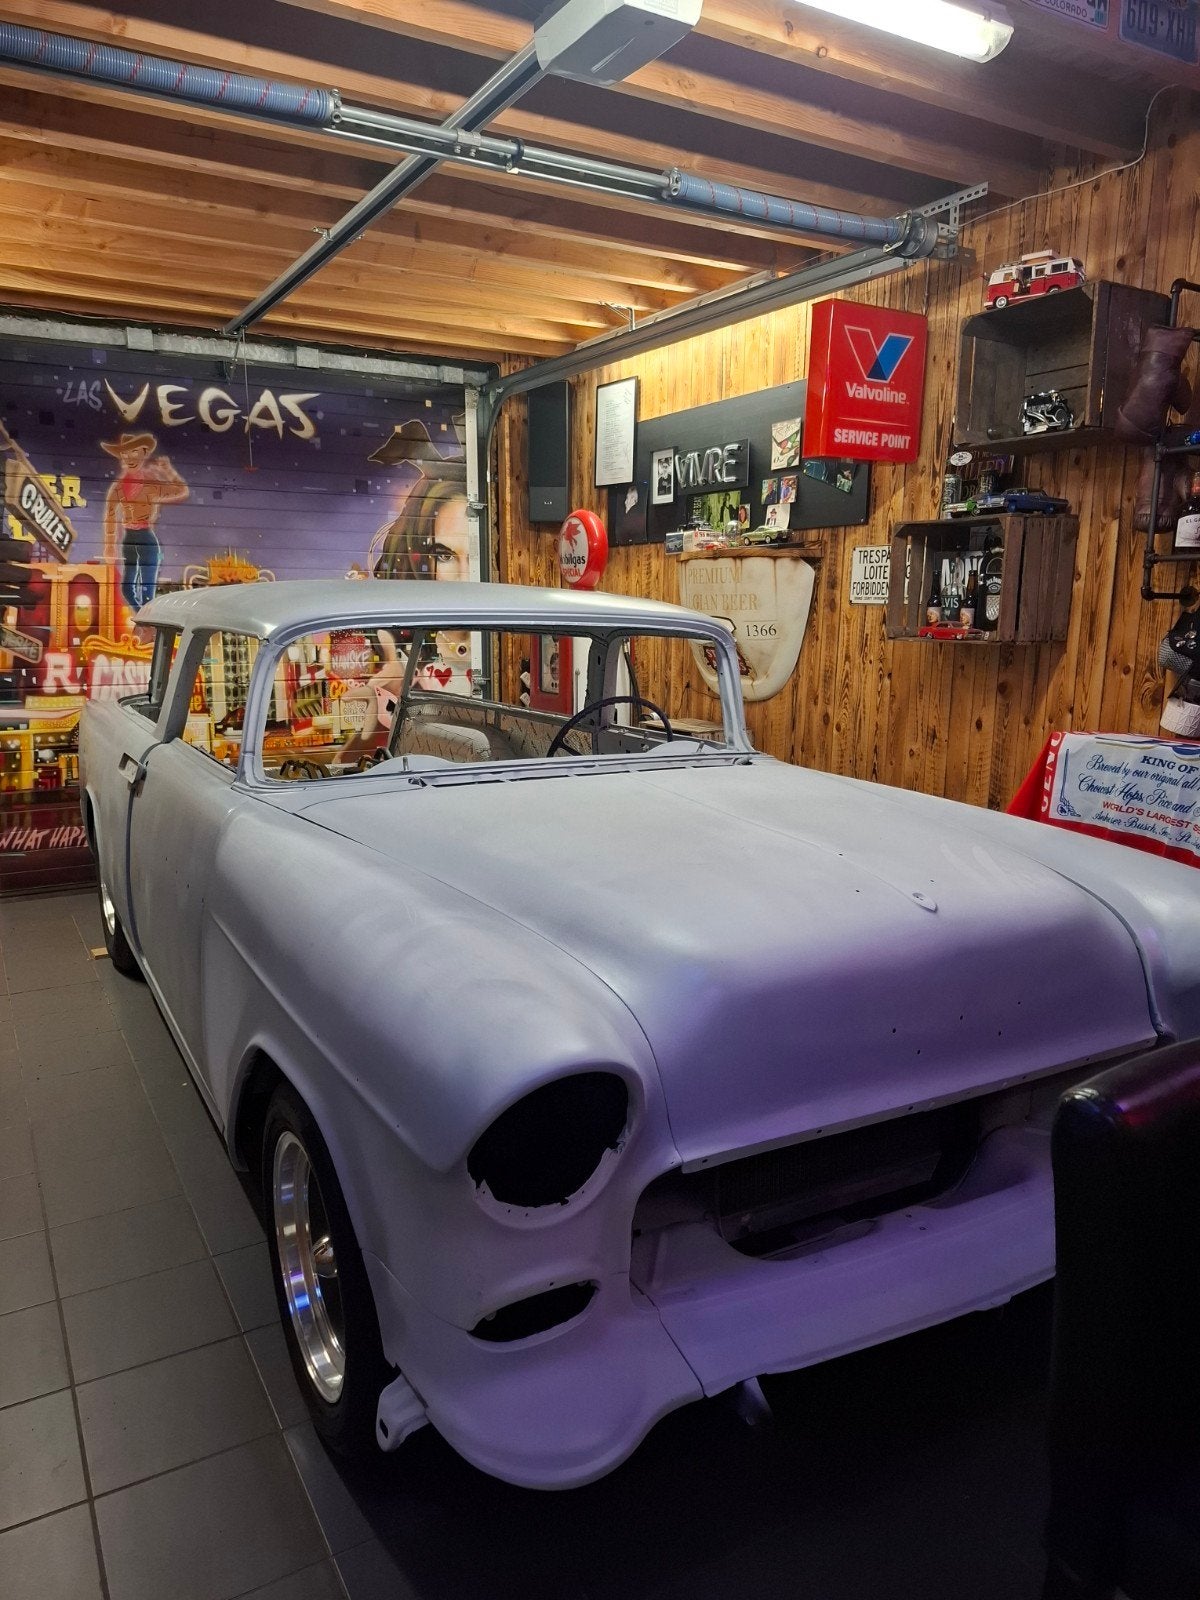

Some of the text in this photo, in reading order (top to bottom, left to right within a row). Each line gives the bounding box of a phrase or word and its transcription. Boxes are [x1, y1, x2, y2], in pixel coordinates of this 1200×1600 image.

[845, 381, 907, 405] Valvoline
[62, 377, 321, 440] LAS VEGAS
[834, 428, 911, 450] SERVICE POINT
[688, 567, 742, 584] PREMIUM
[721, 593, 760, 611] BEER
[746, 624, 777, 637] 1366
[1086, 754, 1199, 790] Brewed by our original all
[1140, 755, 1199, 774] KING OF
[1078, 772, 1117, 796] Choicest
[1171, 801, 1197, 814] and
[1103, 801, 1145, 816] WORLD'S
[1146, 810, 1192, 829] LARGEST
[0, 826, 50, 850] WHAT
